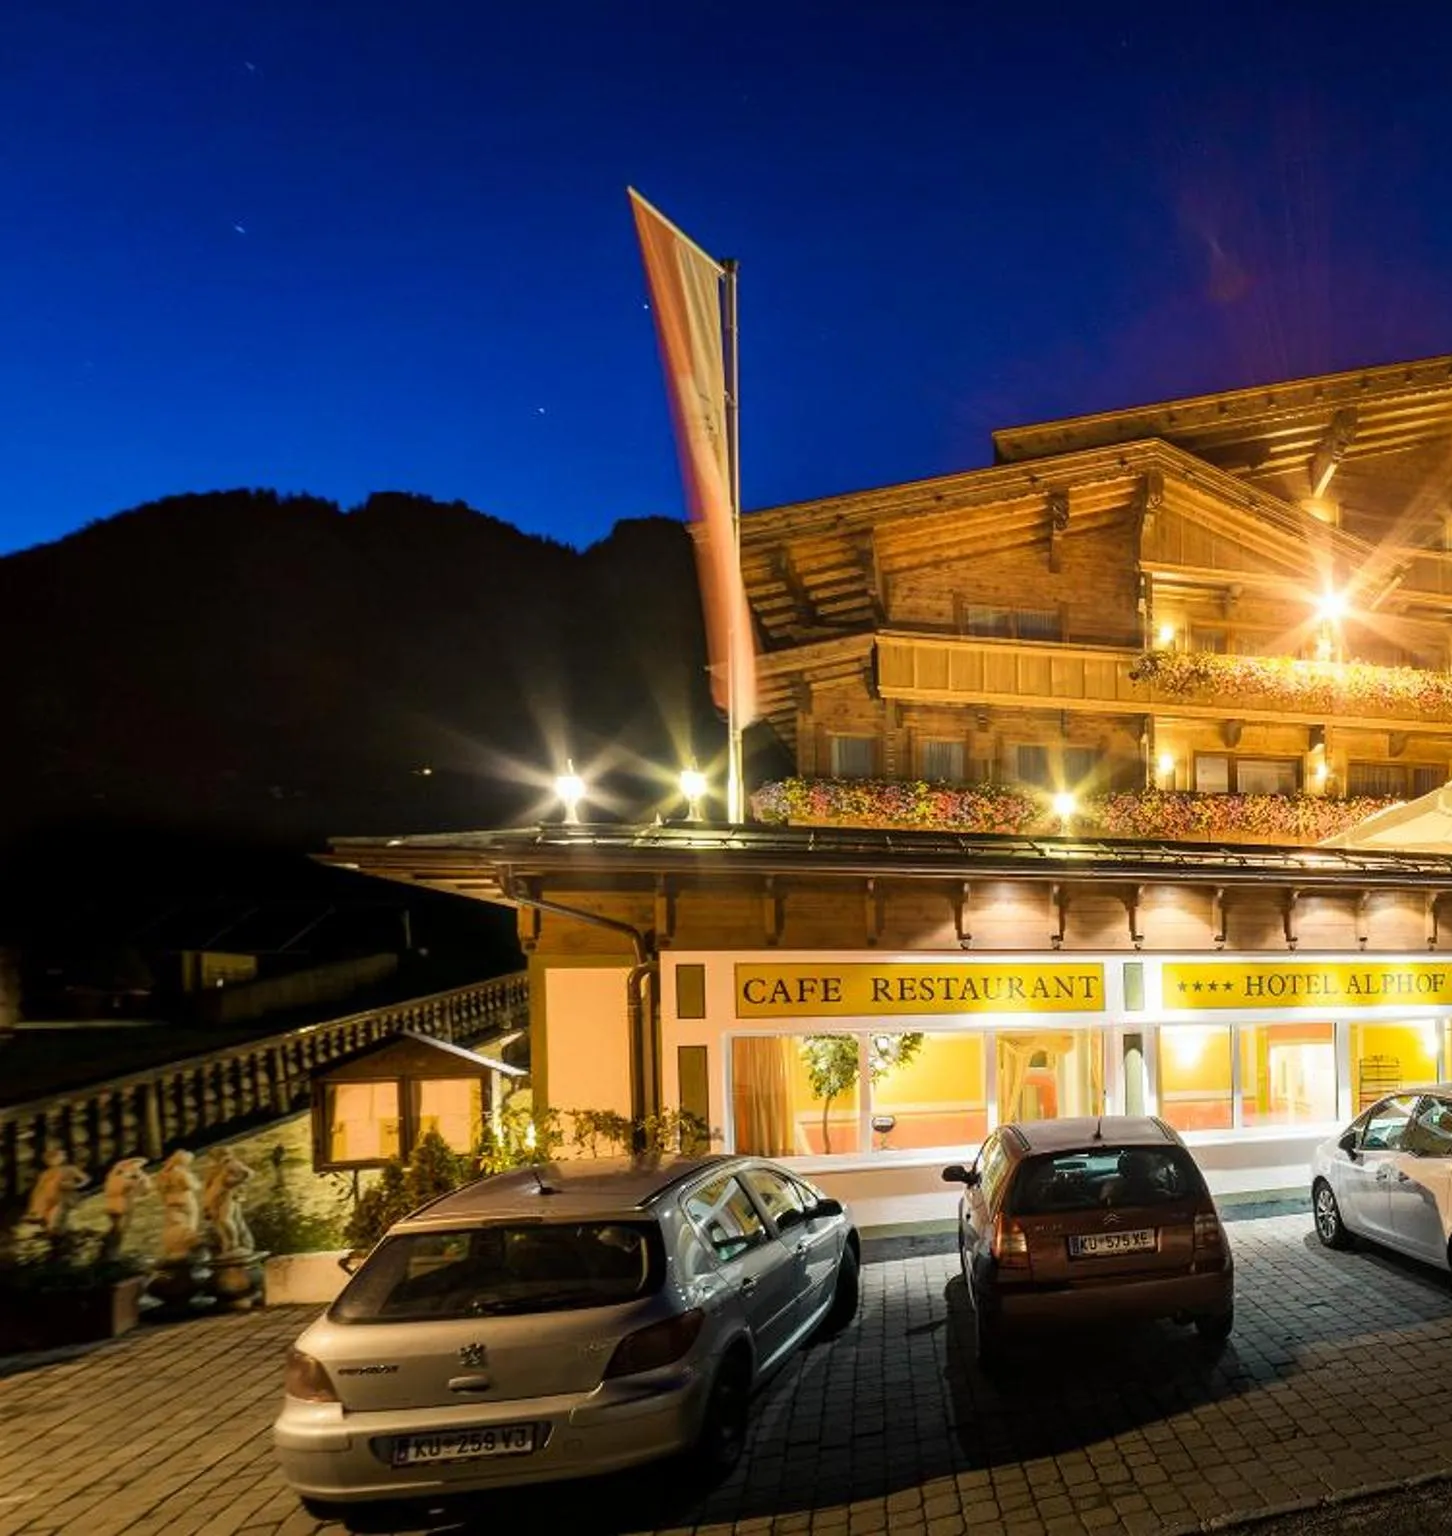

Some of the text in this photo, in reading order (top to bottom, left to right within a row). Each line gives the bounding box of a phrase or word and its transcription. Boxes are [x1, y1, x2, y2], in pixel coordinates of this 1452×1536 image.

[743, 975, 1099, 1005] CAFE RESTAURANT
[1244, 972, 1446, 997] HOTEL ALPHOF
